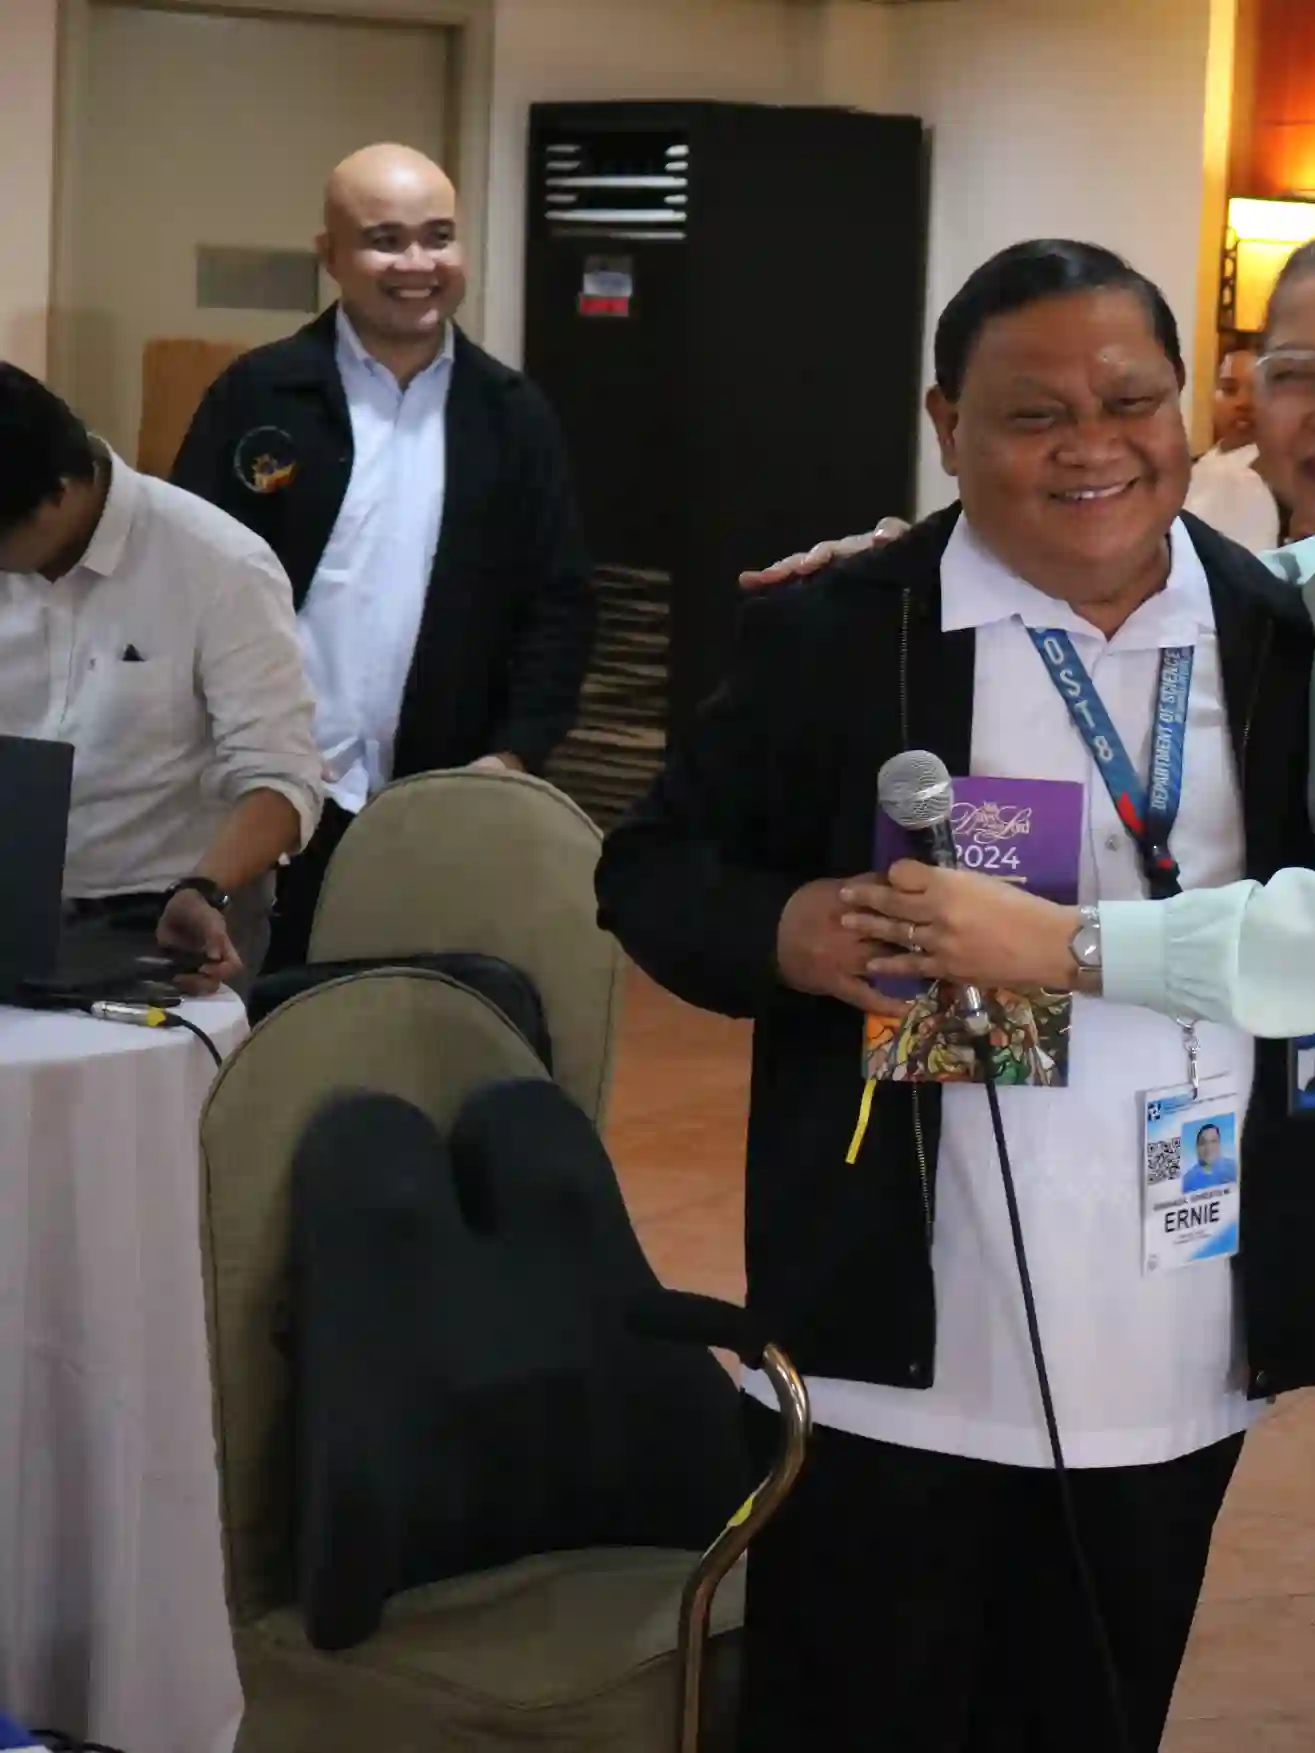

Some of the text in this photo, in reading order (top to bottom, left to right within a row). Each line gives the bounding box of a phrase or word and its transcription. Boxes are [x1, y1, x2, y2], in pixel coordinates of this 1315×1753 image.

[1036, 628, 1115, 762] OST8
[1151, 649, 1180, 810] DEPARTMENT OF SCIENCE
[1164, 1201, 1220, 1233] ERNIE
